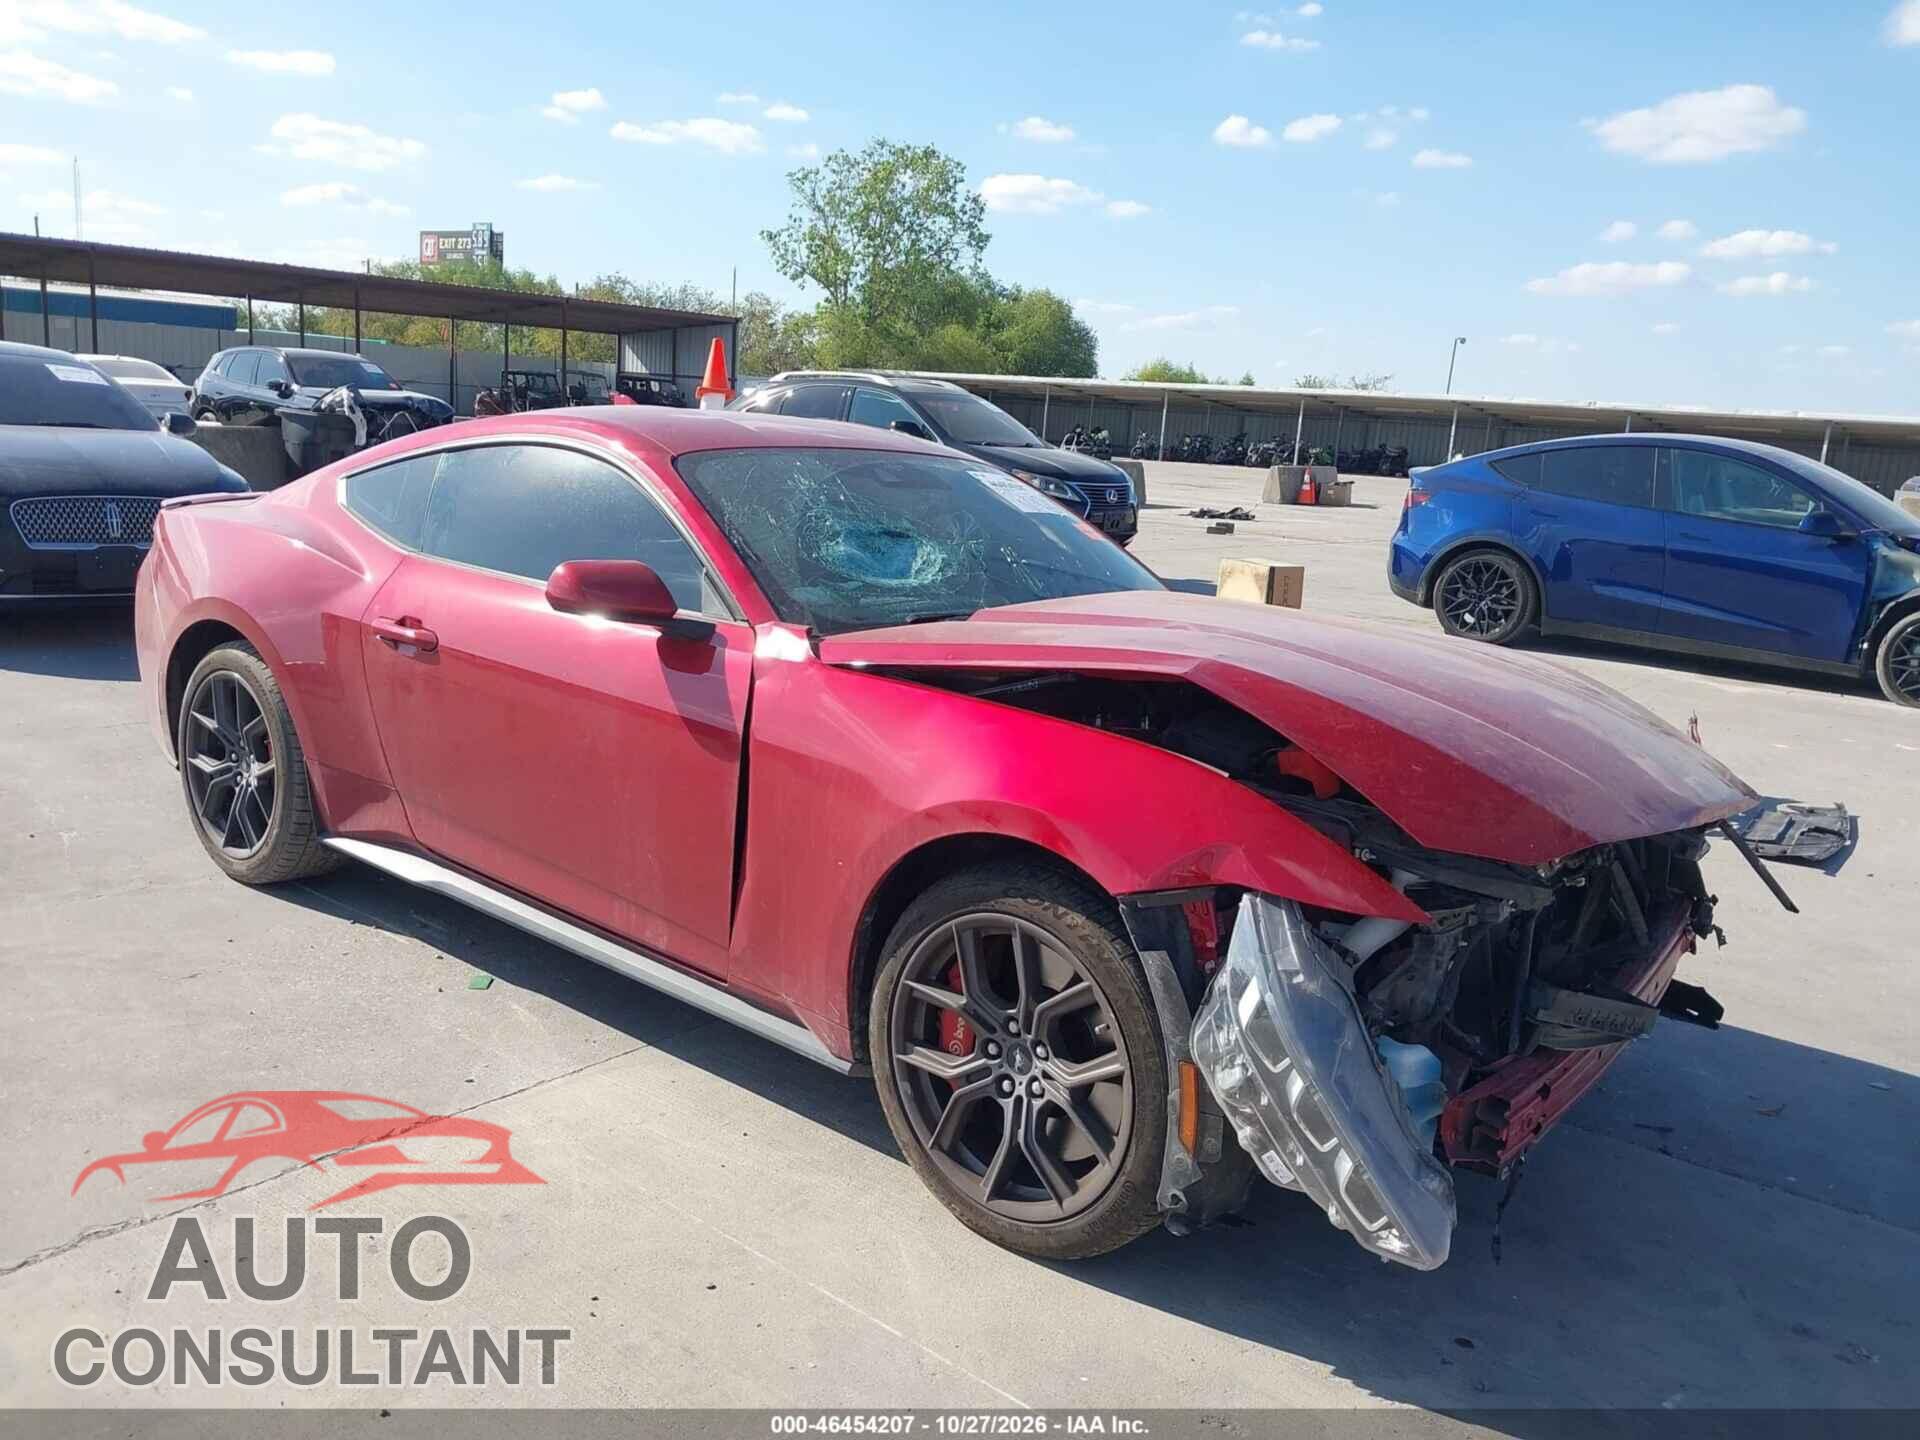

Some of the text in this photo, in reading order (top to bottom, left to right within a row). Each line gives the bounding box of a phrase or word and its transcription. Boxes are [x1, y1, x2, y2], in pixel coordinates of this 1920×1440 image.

[439, 237, 472, 249] EXIT 273
[953, 1016, 966, 1039] bre
